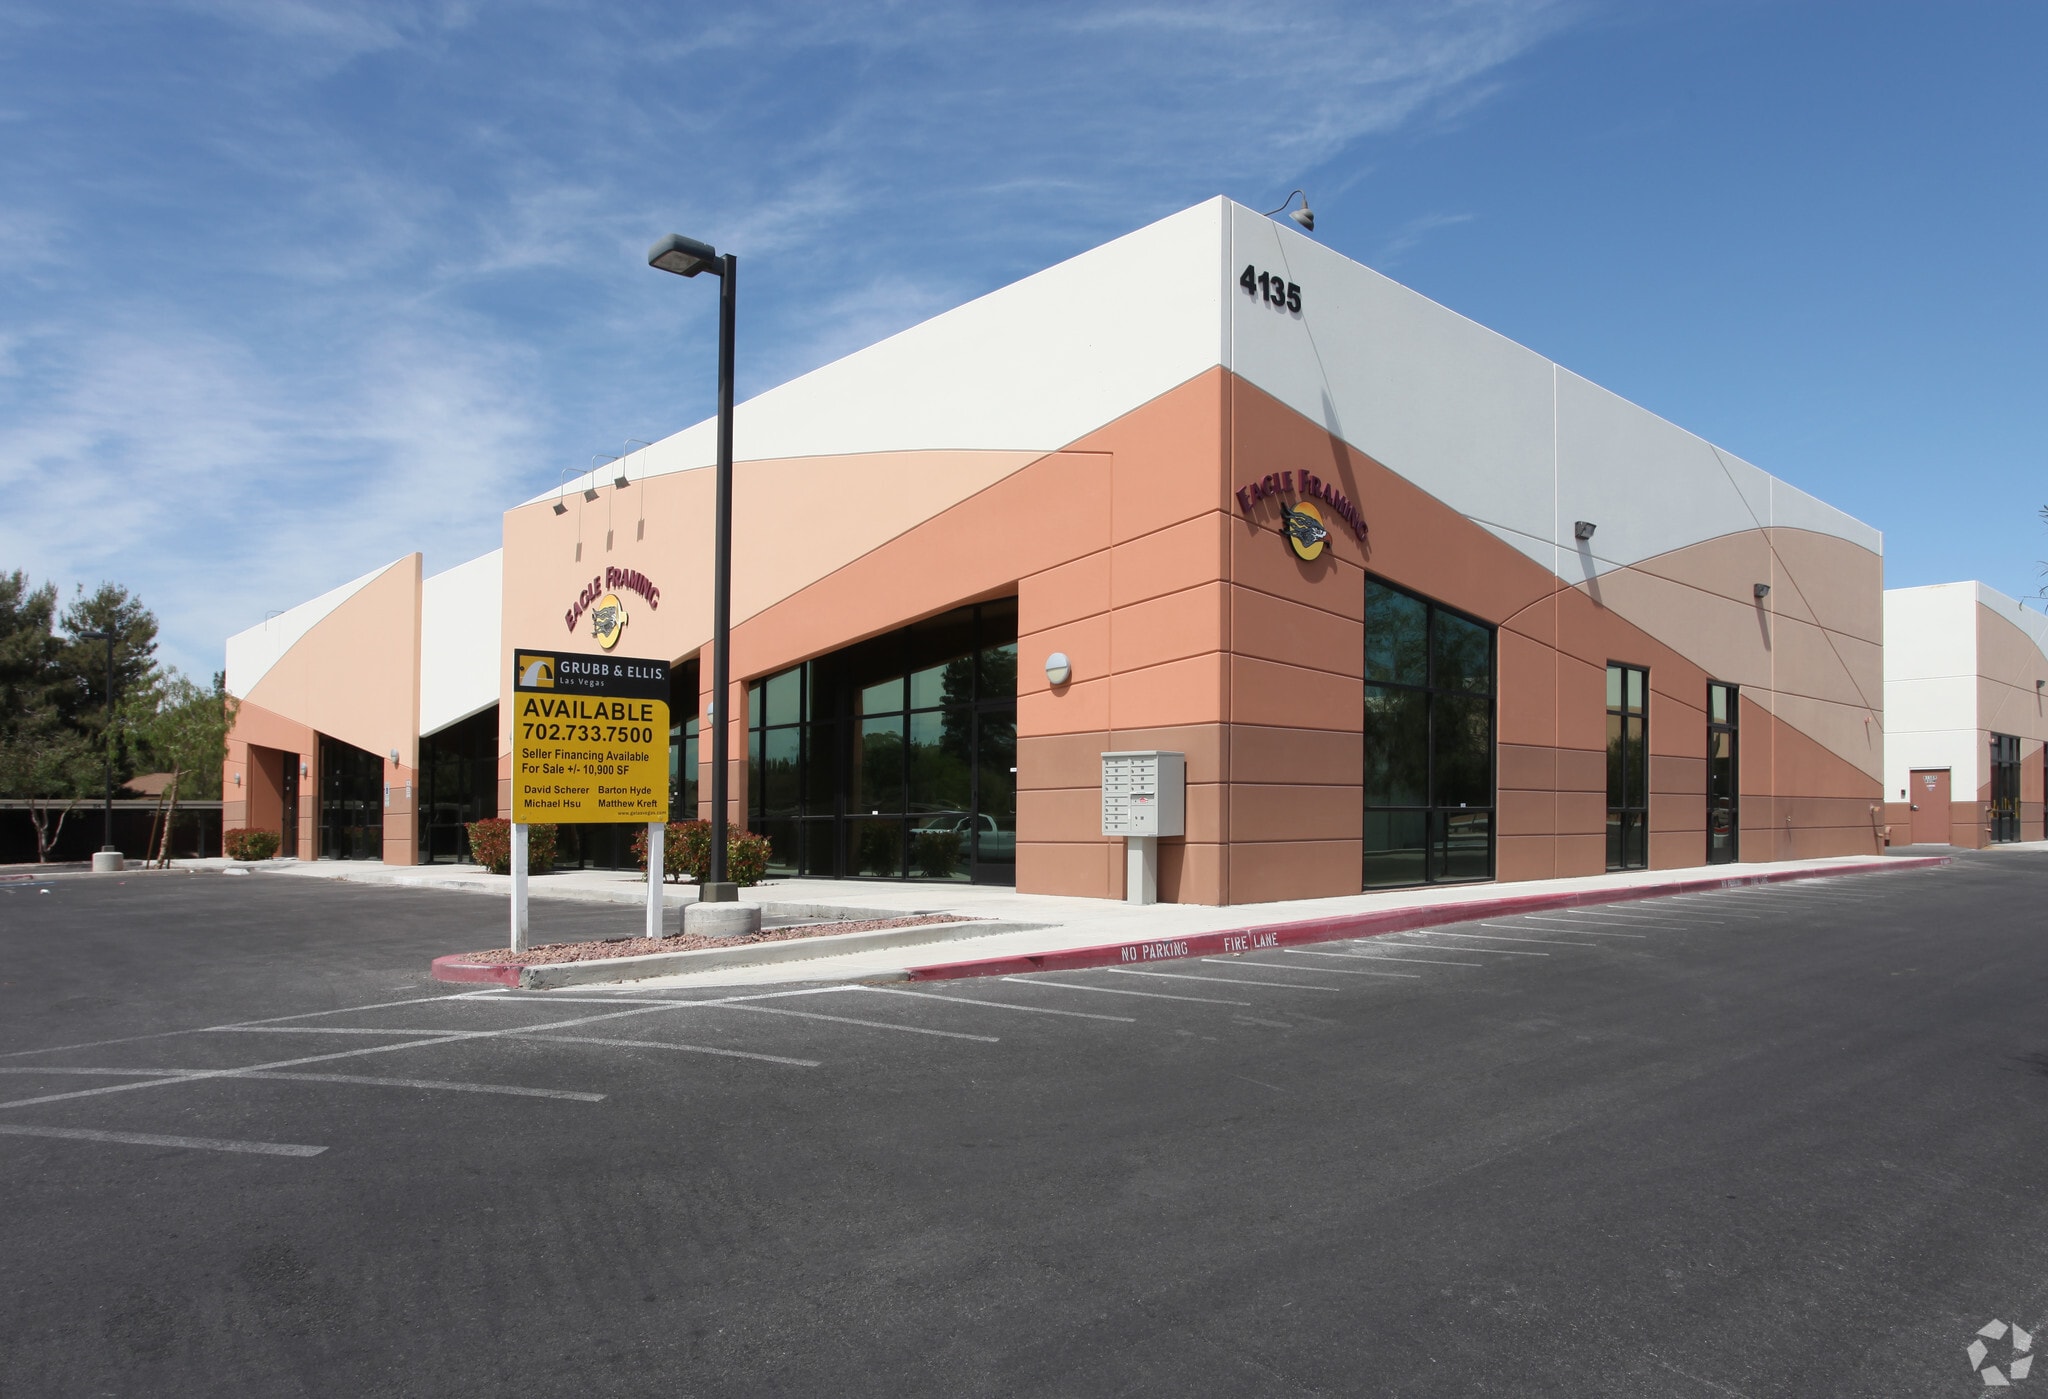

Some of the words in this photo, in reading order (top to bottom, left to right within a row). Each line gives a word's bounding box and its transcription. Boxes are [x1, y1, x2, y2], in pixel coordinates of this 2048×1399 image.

[1240, 265, 1302, 313] 4135
[1236, 470, 1294, 514] EAGLE
[1298, 468, 1369, 543] FRAMING
[565, 576, 602, 633] EAGLE
[560, 661, 609, 676] GRUBB
[613, 665, 623, 677] &
[627, 666, 663, 680] ELLIS
[560, 677, 575, 685] Las
[578, 678, 605, 688] Vegas
[523, 698, 653, 722] AVAILABLE
[523, 723, 653, 744] 702.733.7500
[522, 748, 552, 759] Seller
[555, 749, 604, 762] Financing
[606, 751, 649, 762] Available
[522, 763, 539, 774] For
[543, 763, 564, 774] Sale
[567, 764, 580, 774] +/-
[583, 765, 614, 776] 10,900
[617, 765, 629, 775] SF
[524, 785, 551, 794] David
[554, 785, 589, 795] Scherer
[598, 786, 627, 795] Barton
[630, 786, 652, 796] Hyde
[524, 799, 560, 808] Michael
[563, 799, 581, 808] Hsu
[598, 799, 635, 808] Matthew
[637, 799, 657, 808] Kreft
[1121, 946, 1137, 962] NO
[1142, 941, 1188, 960] PARKING
[1223, 935, 1248, 952] FIRE
[1253, 932, 1279, 948] LANE
